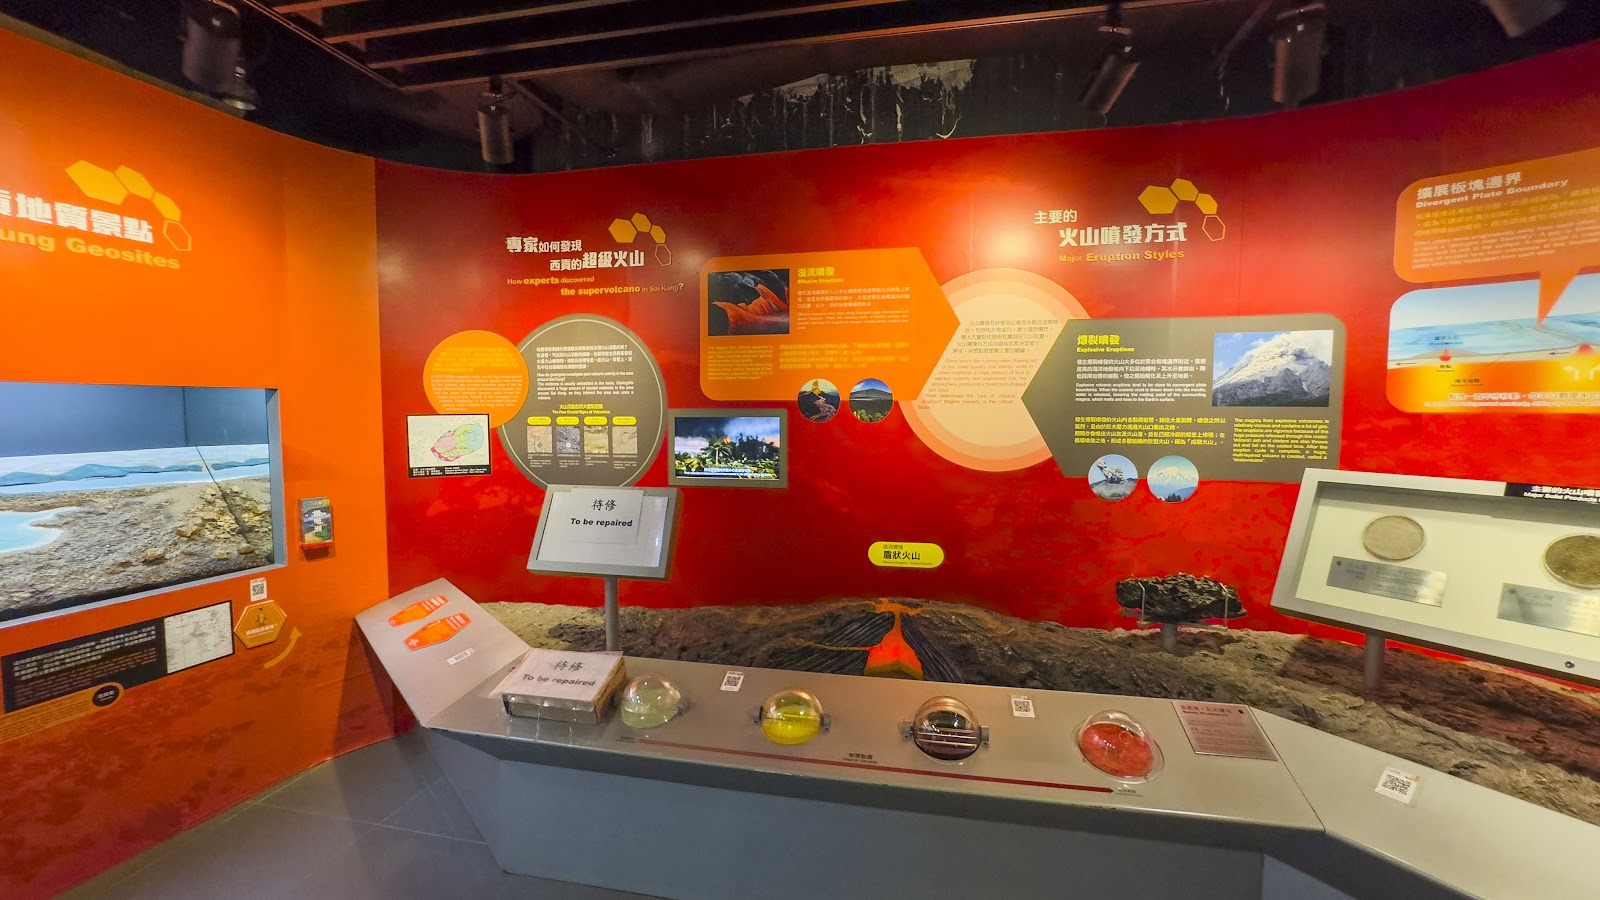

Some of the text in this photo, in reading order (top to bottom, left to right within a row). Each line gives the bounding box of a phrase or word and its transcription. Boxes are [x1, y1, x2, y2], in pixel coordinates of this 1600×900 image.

[1417, 172, 1522, 200] 擴展板塊邊界
[1416, 179, 1568, 208] Divergent Plate Boundary
[1034, 209, 1077, 224] 主要的
[1059, 222, 1187, 247] 火山噴發方式
[0, 229, 181, 269] ung Geosites
[506, 237, 582, 253] 專家如何發現
[550, 250, 645, 271] 西貢的超級火山
[1059, 250, 1184, 263] Major Eruption Styles
[523, 276, 559, 286] experts
[560, 276, 594, 284] discovered
[578, 285, 640, 296] supervolcano
[1531, 485, 1600, 498] 主要的火山噴
[592, 499, 616, 511] 待修
[1564, 495, 1598, 503] Products
[596, 519, 633, 527] repaired
[883, 551, 920, 560] 盾狀火山
[553, 661, 583, 671] 待修
[551, 676, 596, 686] repaired
